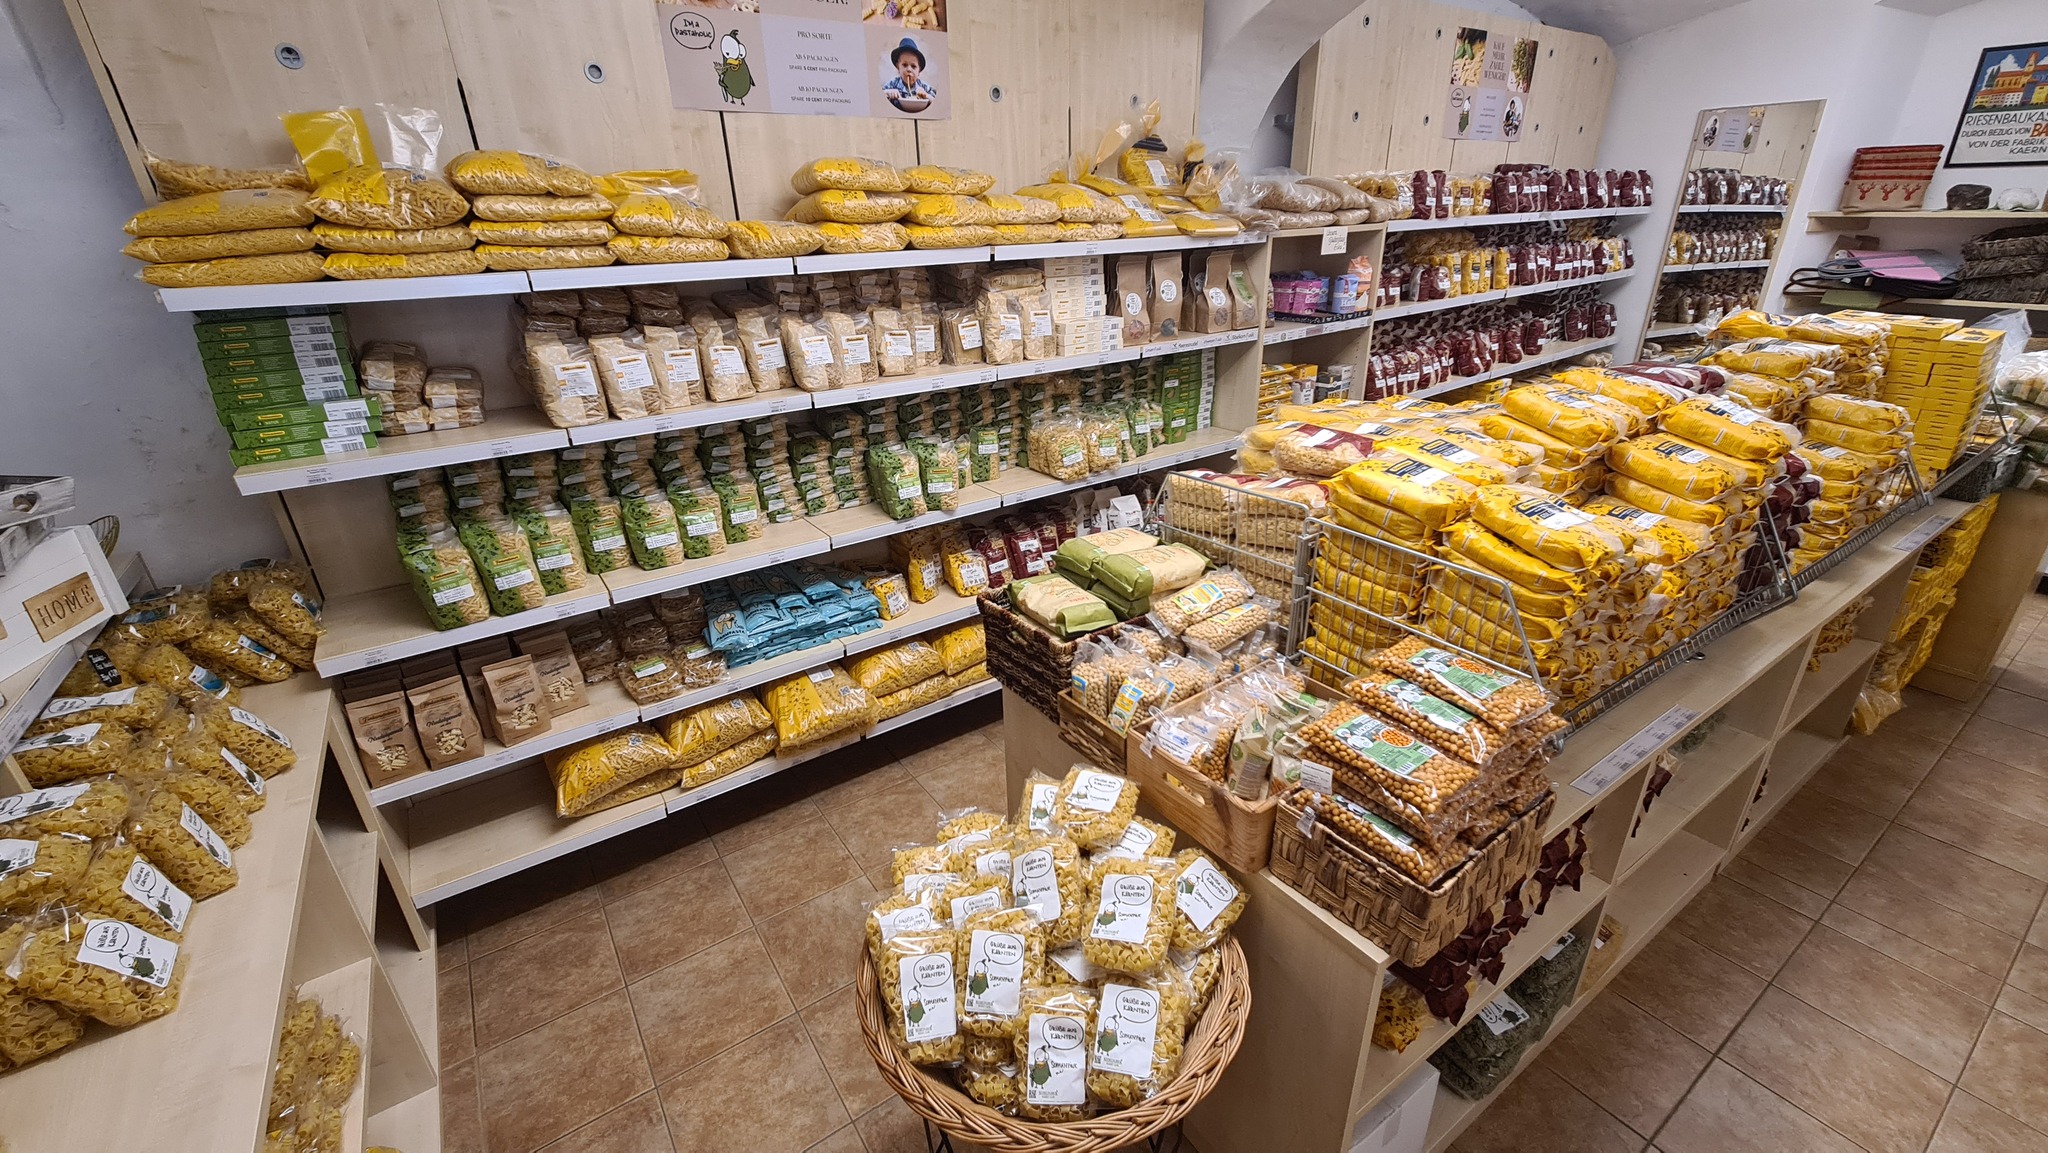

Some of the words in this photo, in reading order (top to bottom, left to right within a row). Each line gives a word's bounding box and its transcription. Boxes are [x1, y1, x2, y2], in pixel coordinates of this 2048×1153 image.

[797, 31, 810, 39] PRO
[1961, 130, 1987, 138] DURCH
[1988, 128, 2012, 136] BEZUG
[2012, 138, 2046, 146] FABRIK
[2009, 146, 2047, 154] KAERN
[36, 584, 95, 628] HOME
